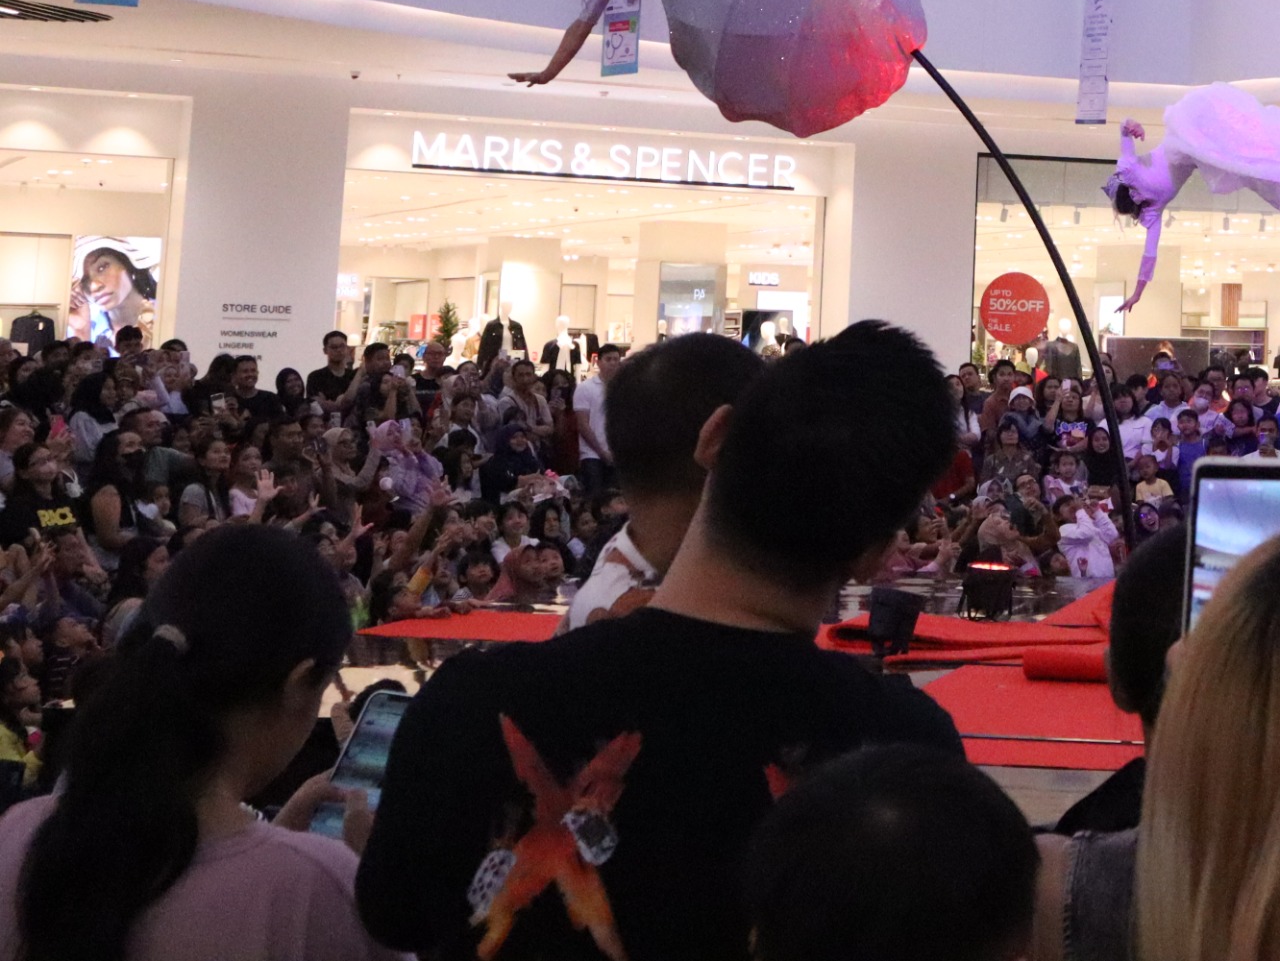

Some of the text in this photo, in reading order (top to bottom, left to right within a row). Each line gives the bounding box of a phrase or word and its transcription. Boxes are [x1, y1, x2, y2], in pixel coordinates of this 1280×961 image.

[411, 130, 797, 188] MARKS & SPENCER
[222, 303, 292, 315] STORE GUIDE
[220, 330, 278, 338] WOMENSWEAR
[218, 342, 255, 350] LINGERIE
